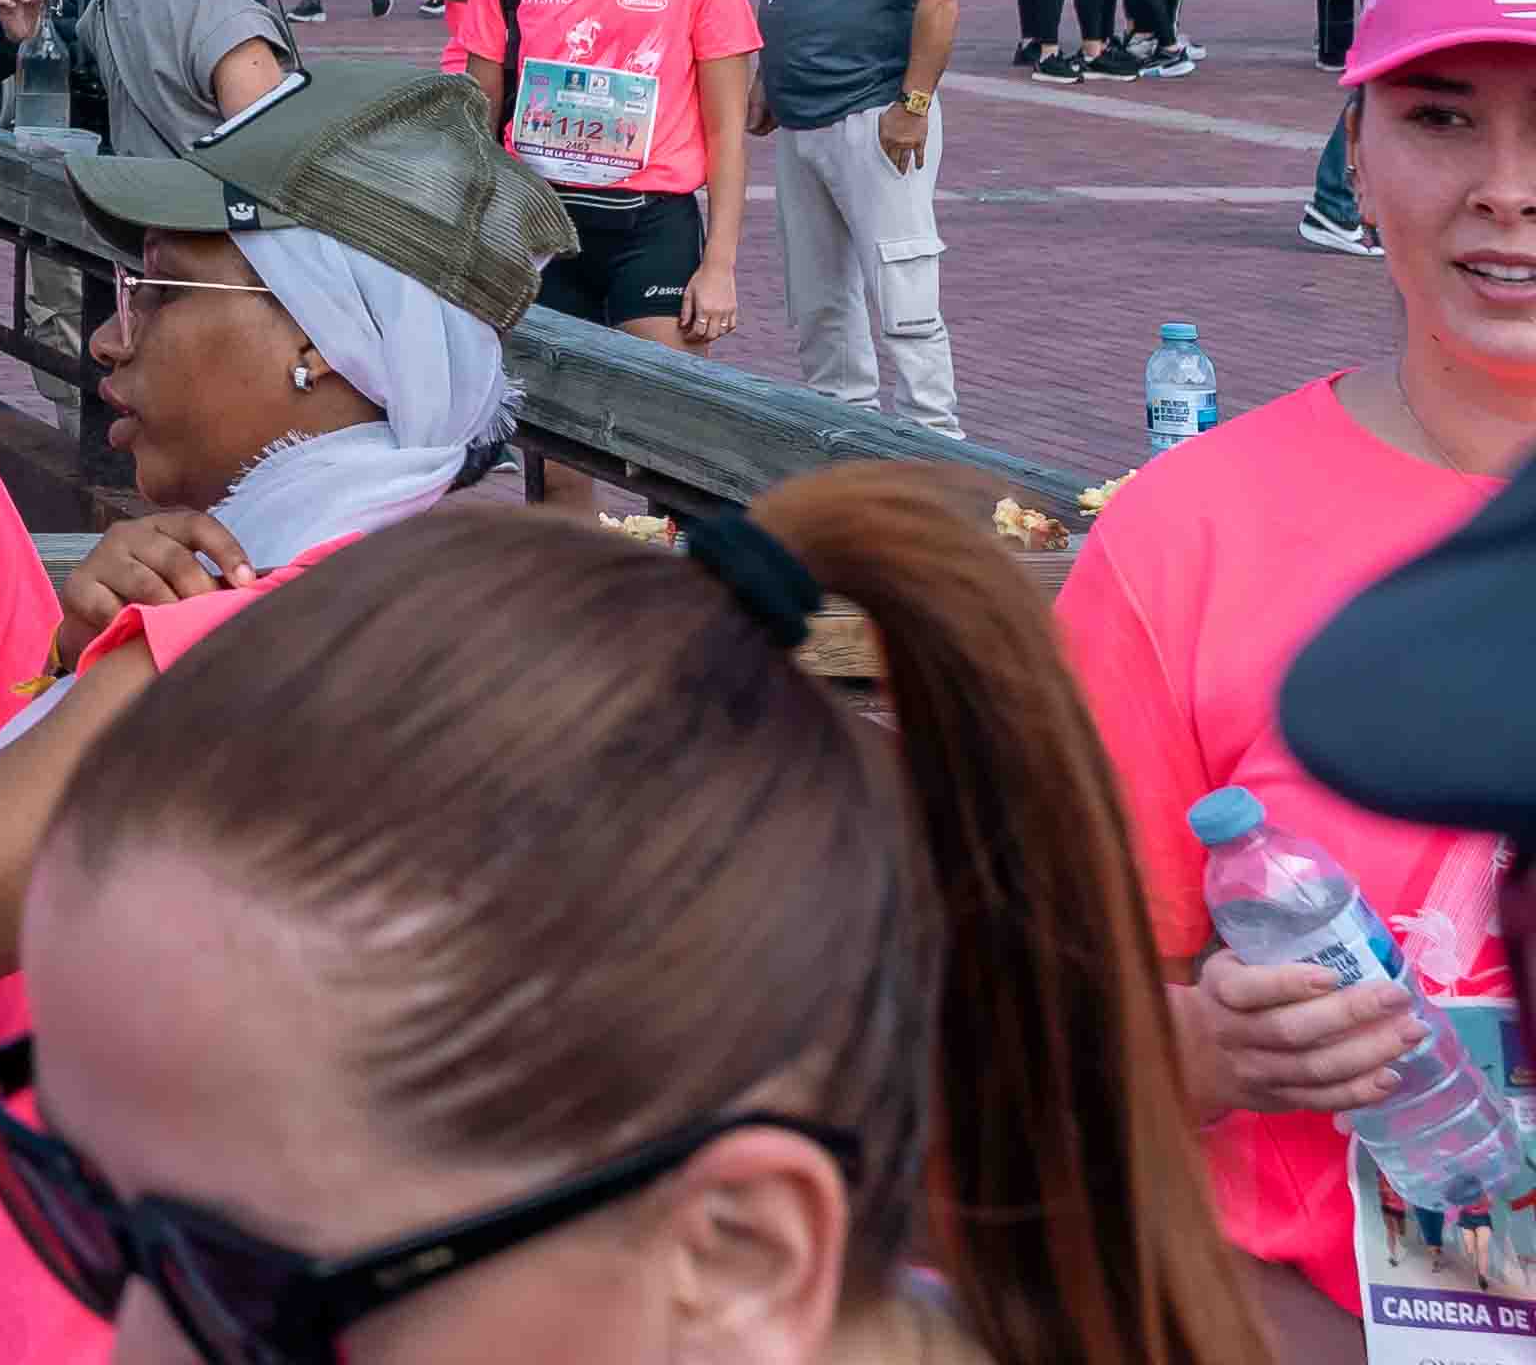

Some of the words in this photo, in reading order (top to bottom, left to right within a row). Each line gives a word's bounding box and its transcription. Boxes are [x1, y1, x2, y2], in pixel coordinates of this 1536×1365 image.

[558, 115, 603, 141] 112
[1382, 1296, 1492, 1327] CARRERA
[1498, 1306, 1530, 1330] DE
